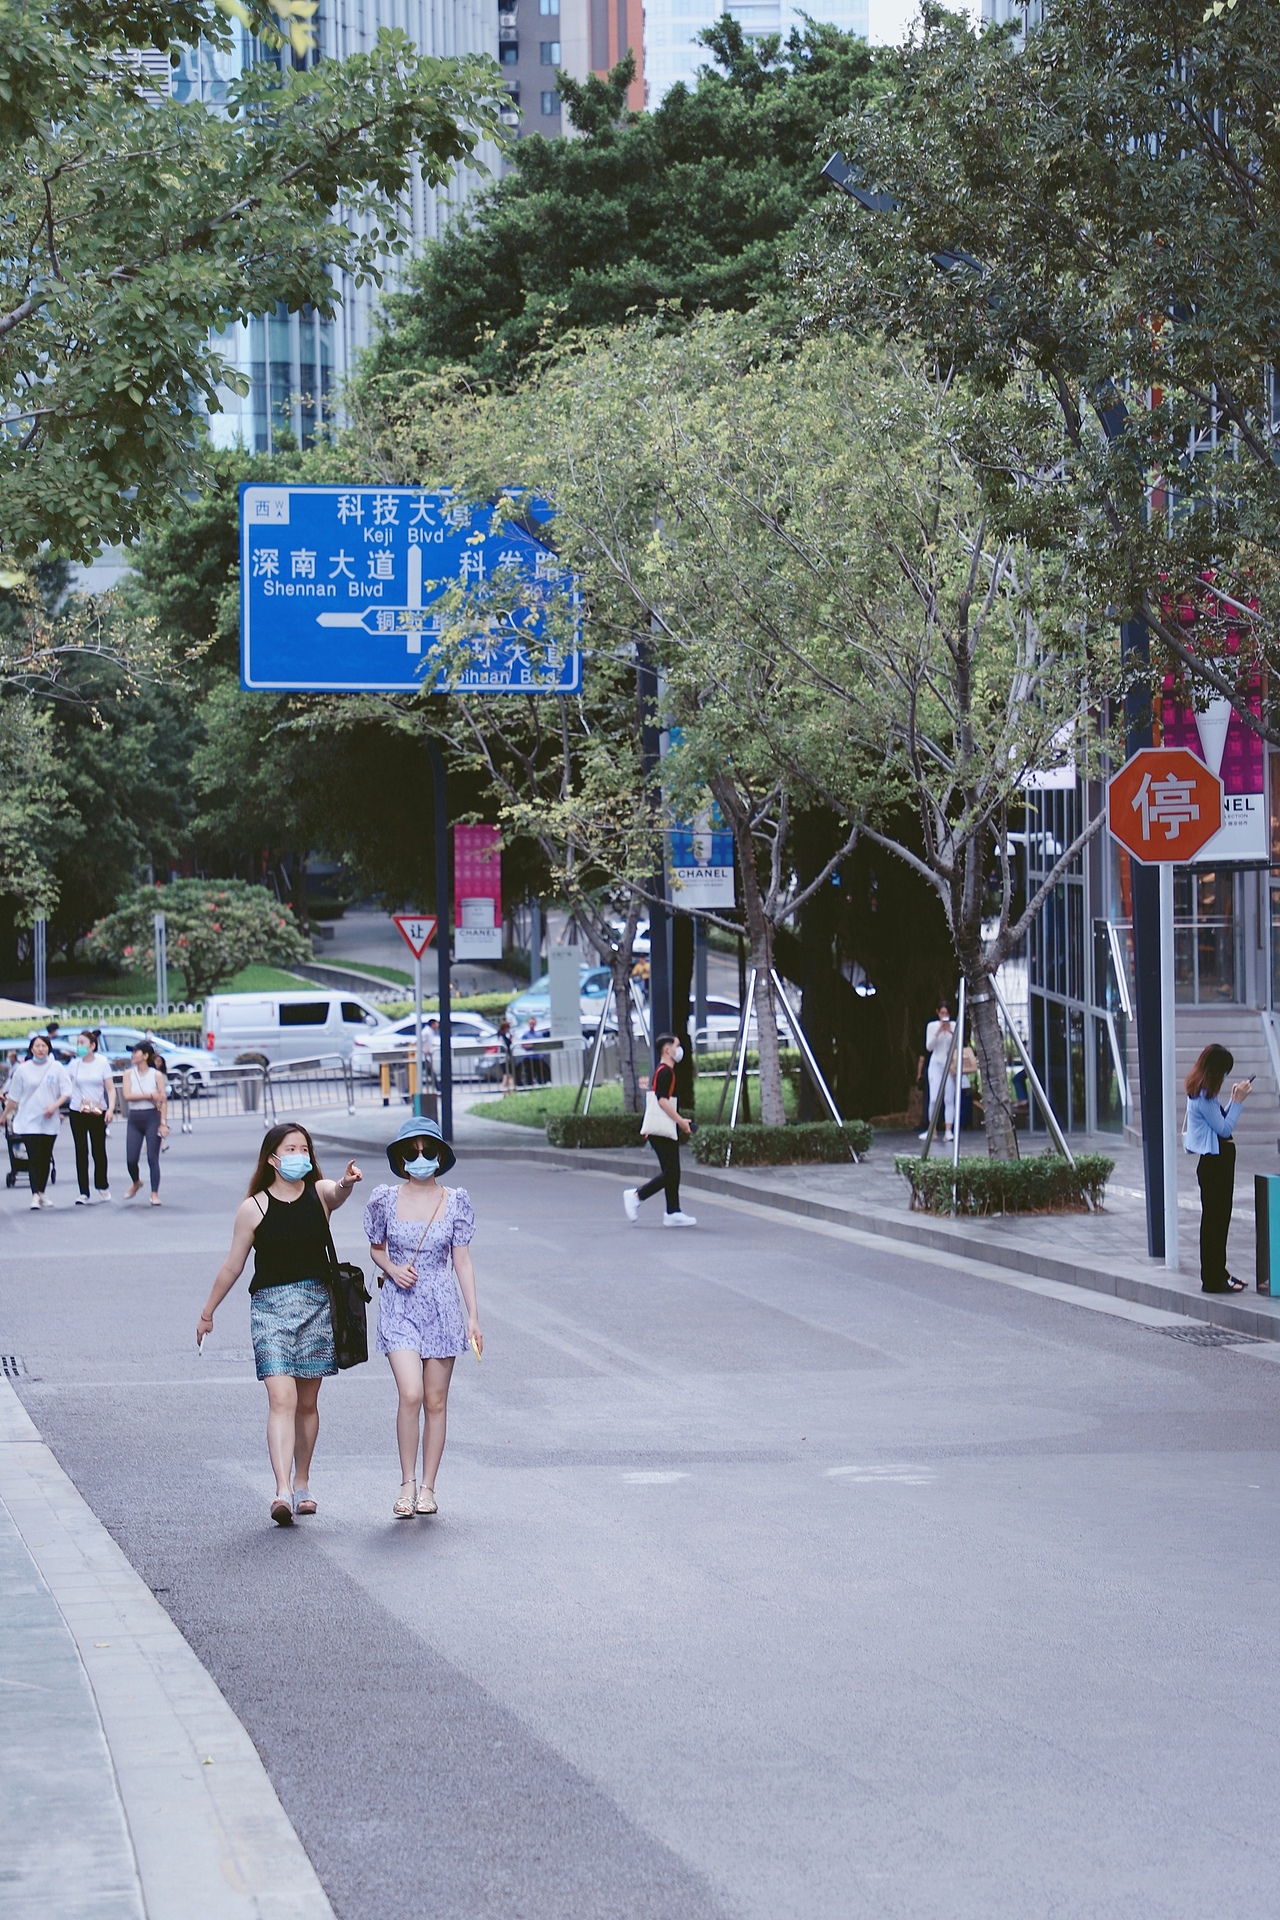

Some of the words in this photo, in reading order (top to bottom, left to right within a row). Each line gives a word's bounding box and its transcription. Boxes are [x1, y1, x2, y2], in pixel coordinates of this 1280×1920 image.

[255, 500, 270, 517] 西
[275, 500, 284, 509] W
[337, 494, 471, 526] 科技大道
[363, 527, 393, 546] Keji
[407, 527, 444, 544] Blvd
[252, 548, 395, 580] 深南大道
[263, 579, 337, 597] Shennan
[348, 581, 384, 598] Blvd
[1131, 771, 1200, 842] 停
[678, 869, 728, 879] CHANEL
[410, 924, 424, 940] 让
